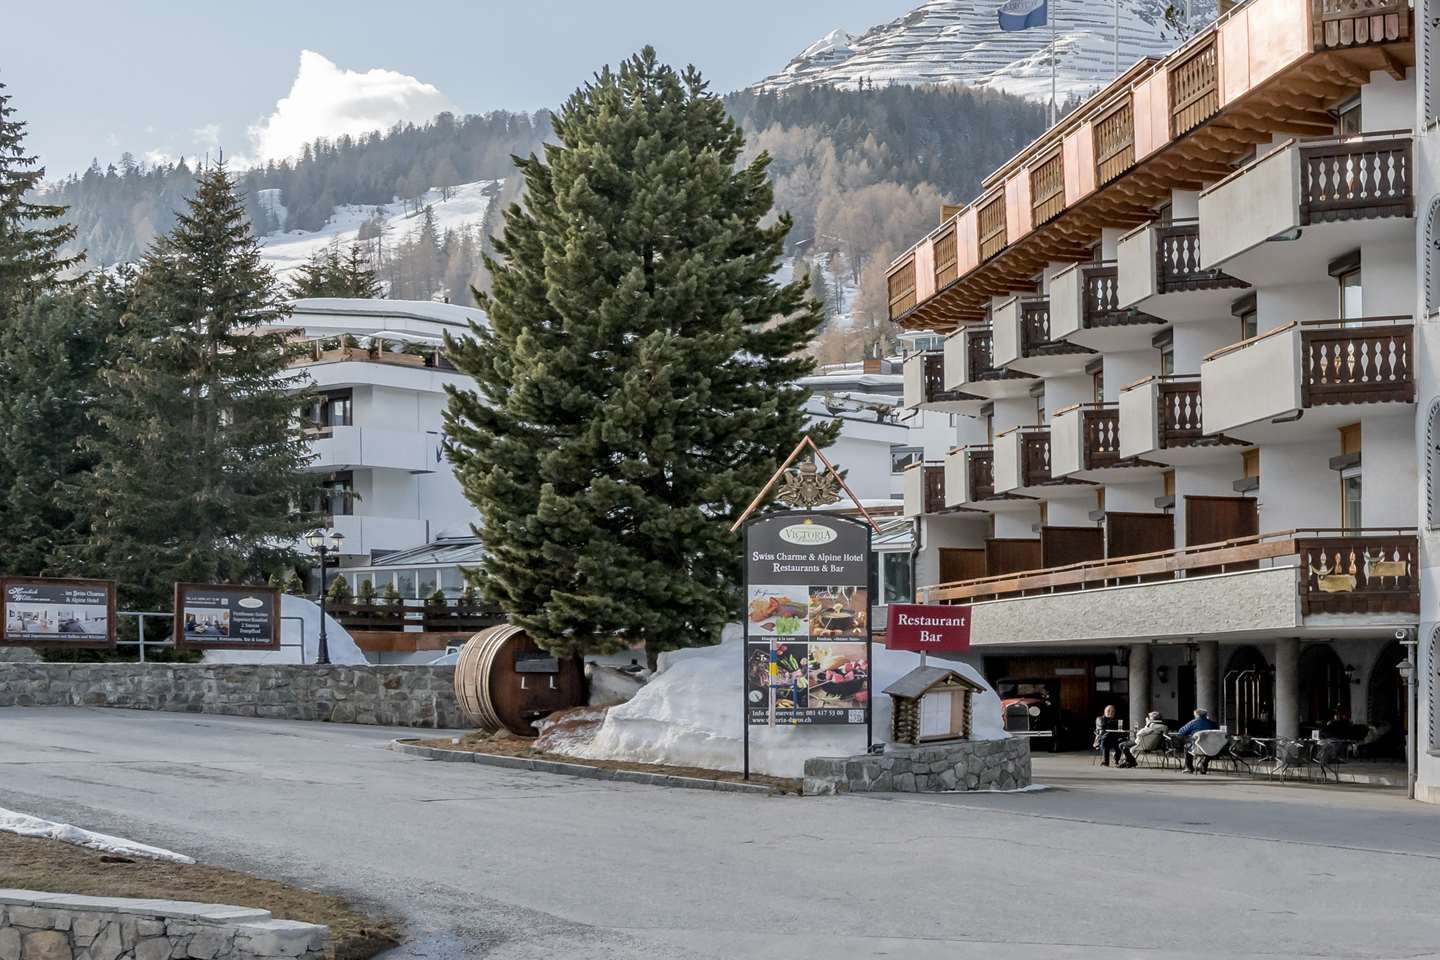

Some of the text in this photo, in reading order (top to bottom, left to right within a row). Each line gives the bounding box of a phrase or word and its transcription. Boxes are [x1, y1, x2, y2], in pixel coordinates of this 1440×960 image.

[785, 528, 832, 540] VICTORIA
[752, 551, 863, 563] Swiss Charme & Alpine Hotel
[773, 563, 844, 572] Restaurants & Bar
[898, 613, 965, 627] Restaurant
[920, 630, 943, 642] Bar
